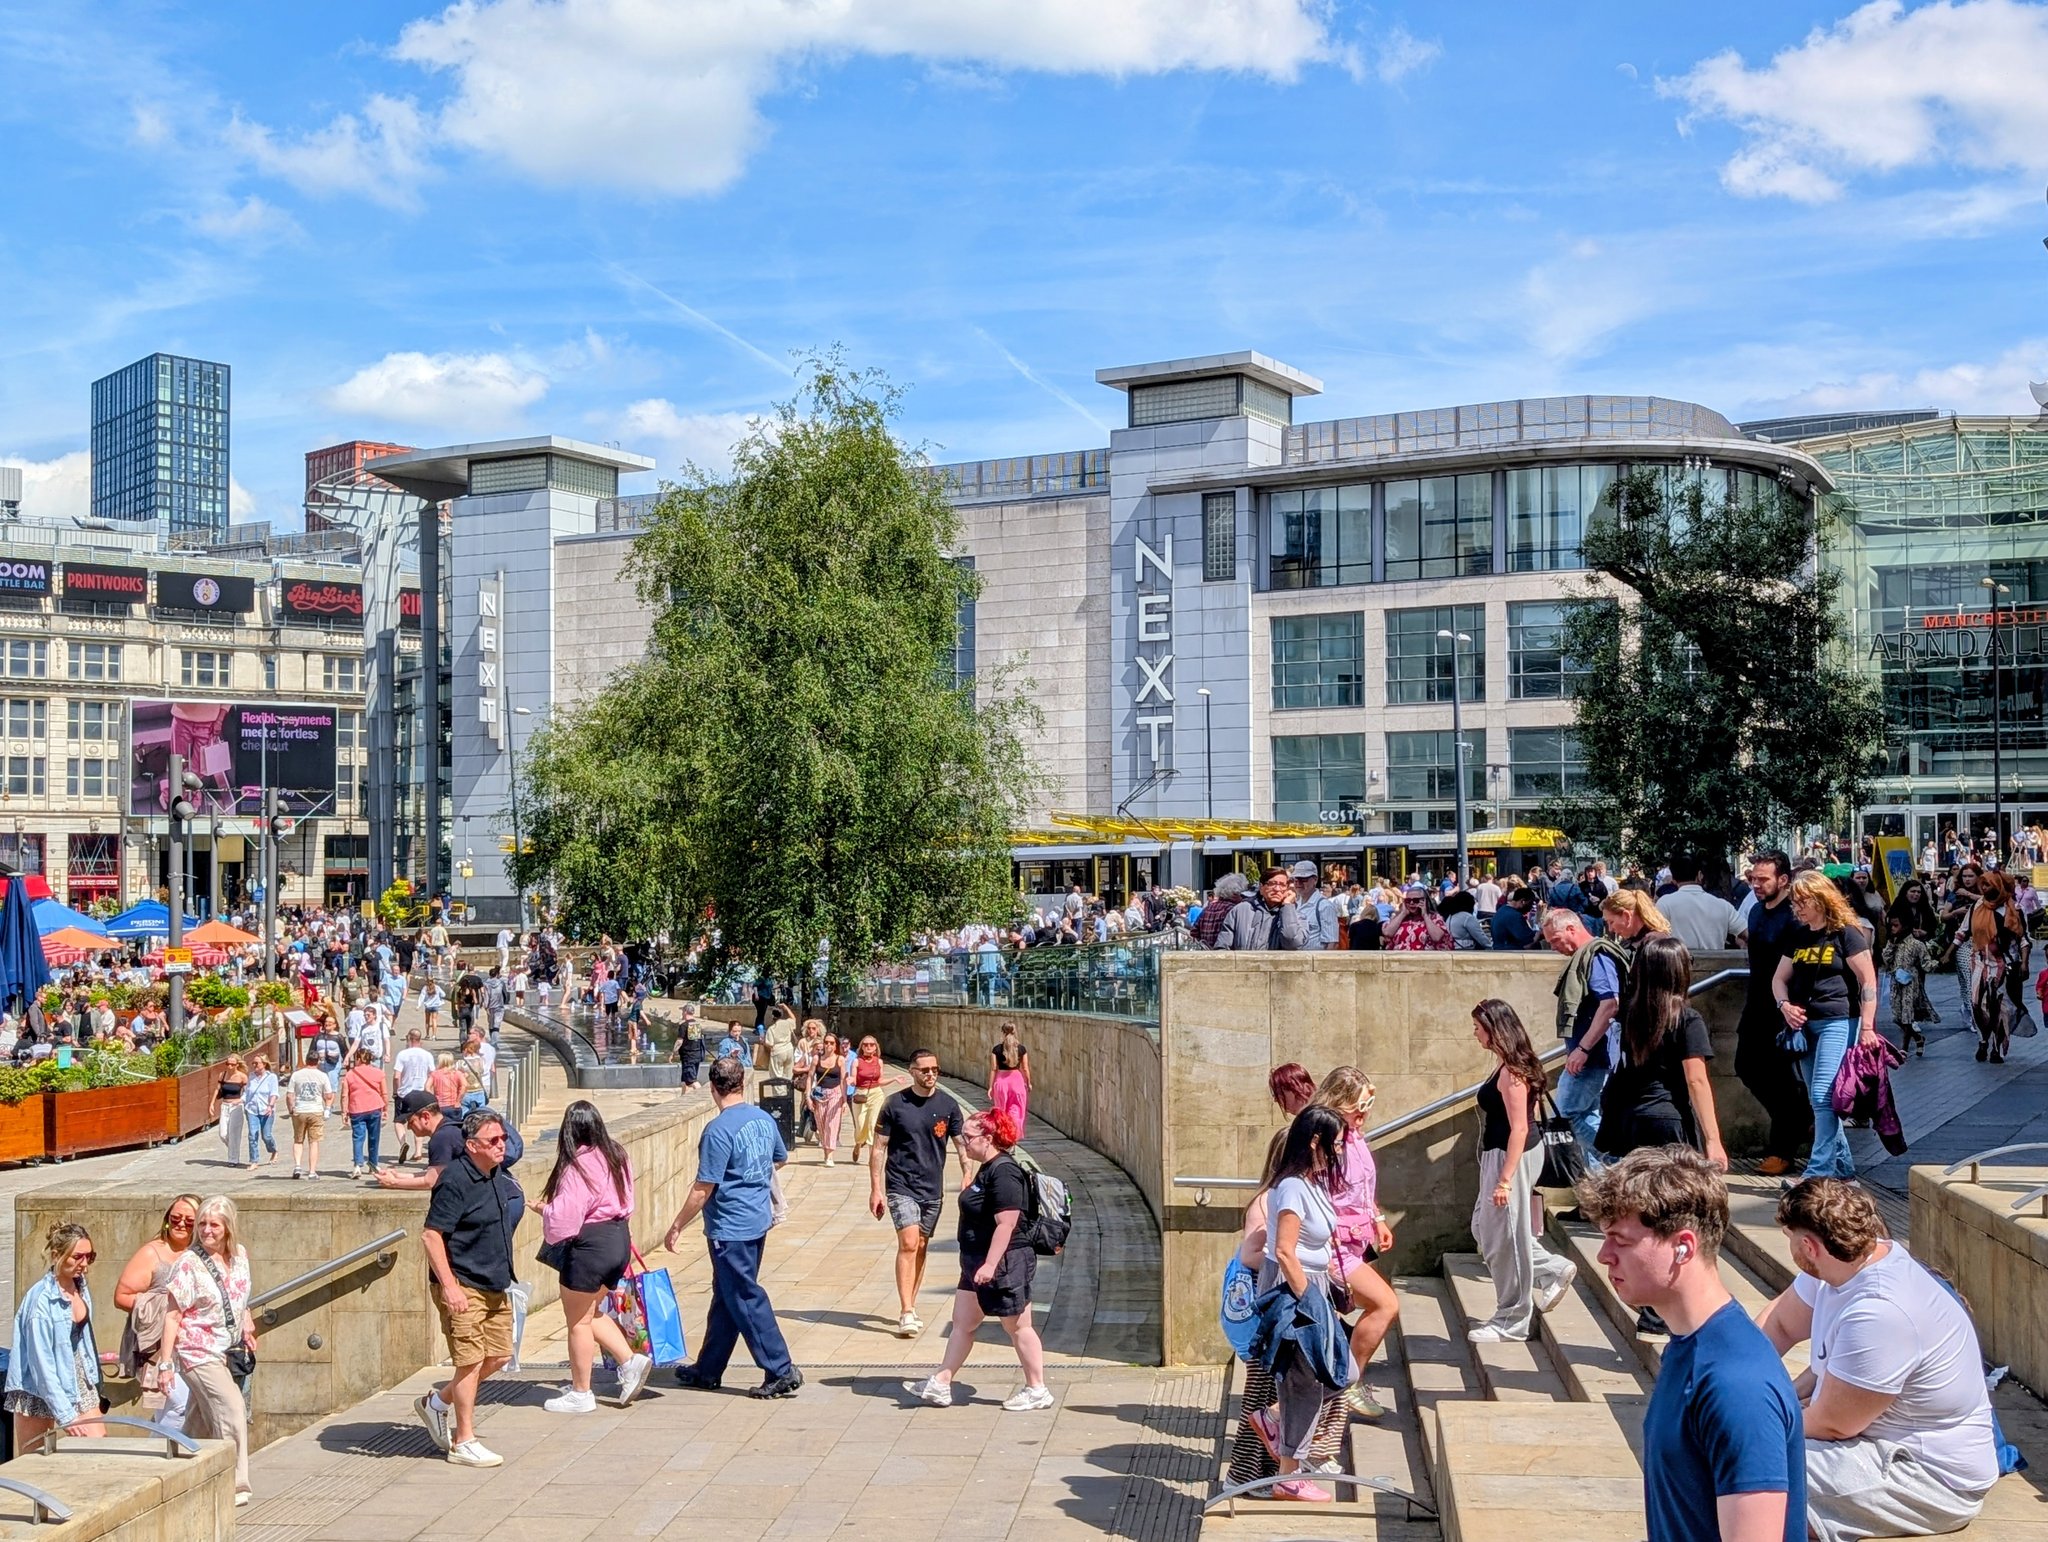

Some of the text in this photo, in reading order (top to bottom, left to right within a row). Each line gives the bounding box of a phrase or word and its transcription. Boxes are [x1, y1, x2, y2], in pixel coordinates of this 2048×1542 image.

[23, 581, 45, 590] BAR
[67, 572, 144, 593] PRINTWORKS
[1922, 610, 2048, 629] MANCHESTE
[1135, 533, 1174, 762] NEXT
[481, 592, 495, 721] NEXT
[281, 716, 332, 727] payments
[270, 728, 319, 739] efortless
[241, 741, 289, 751] chekout
[1319, 809, 1365, 822] COSTA
